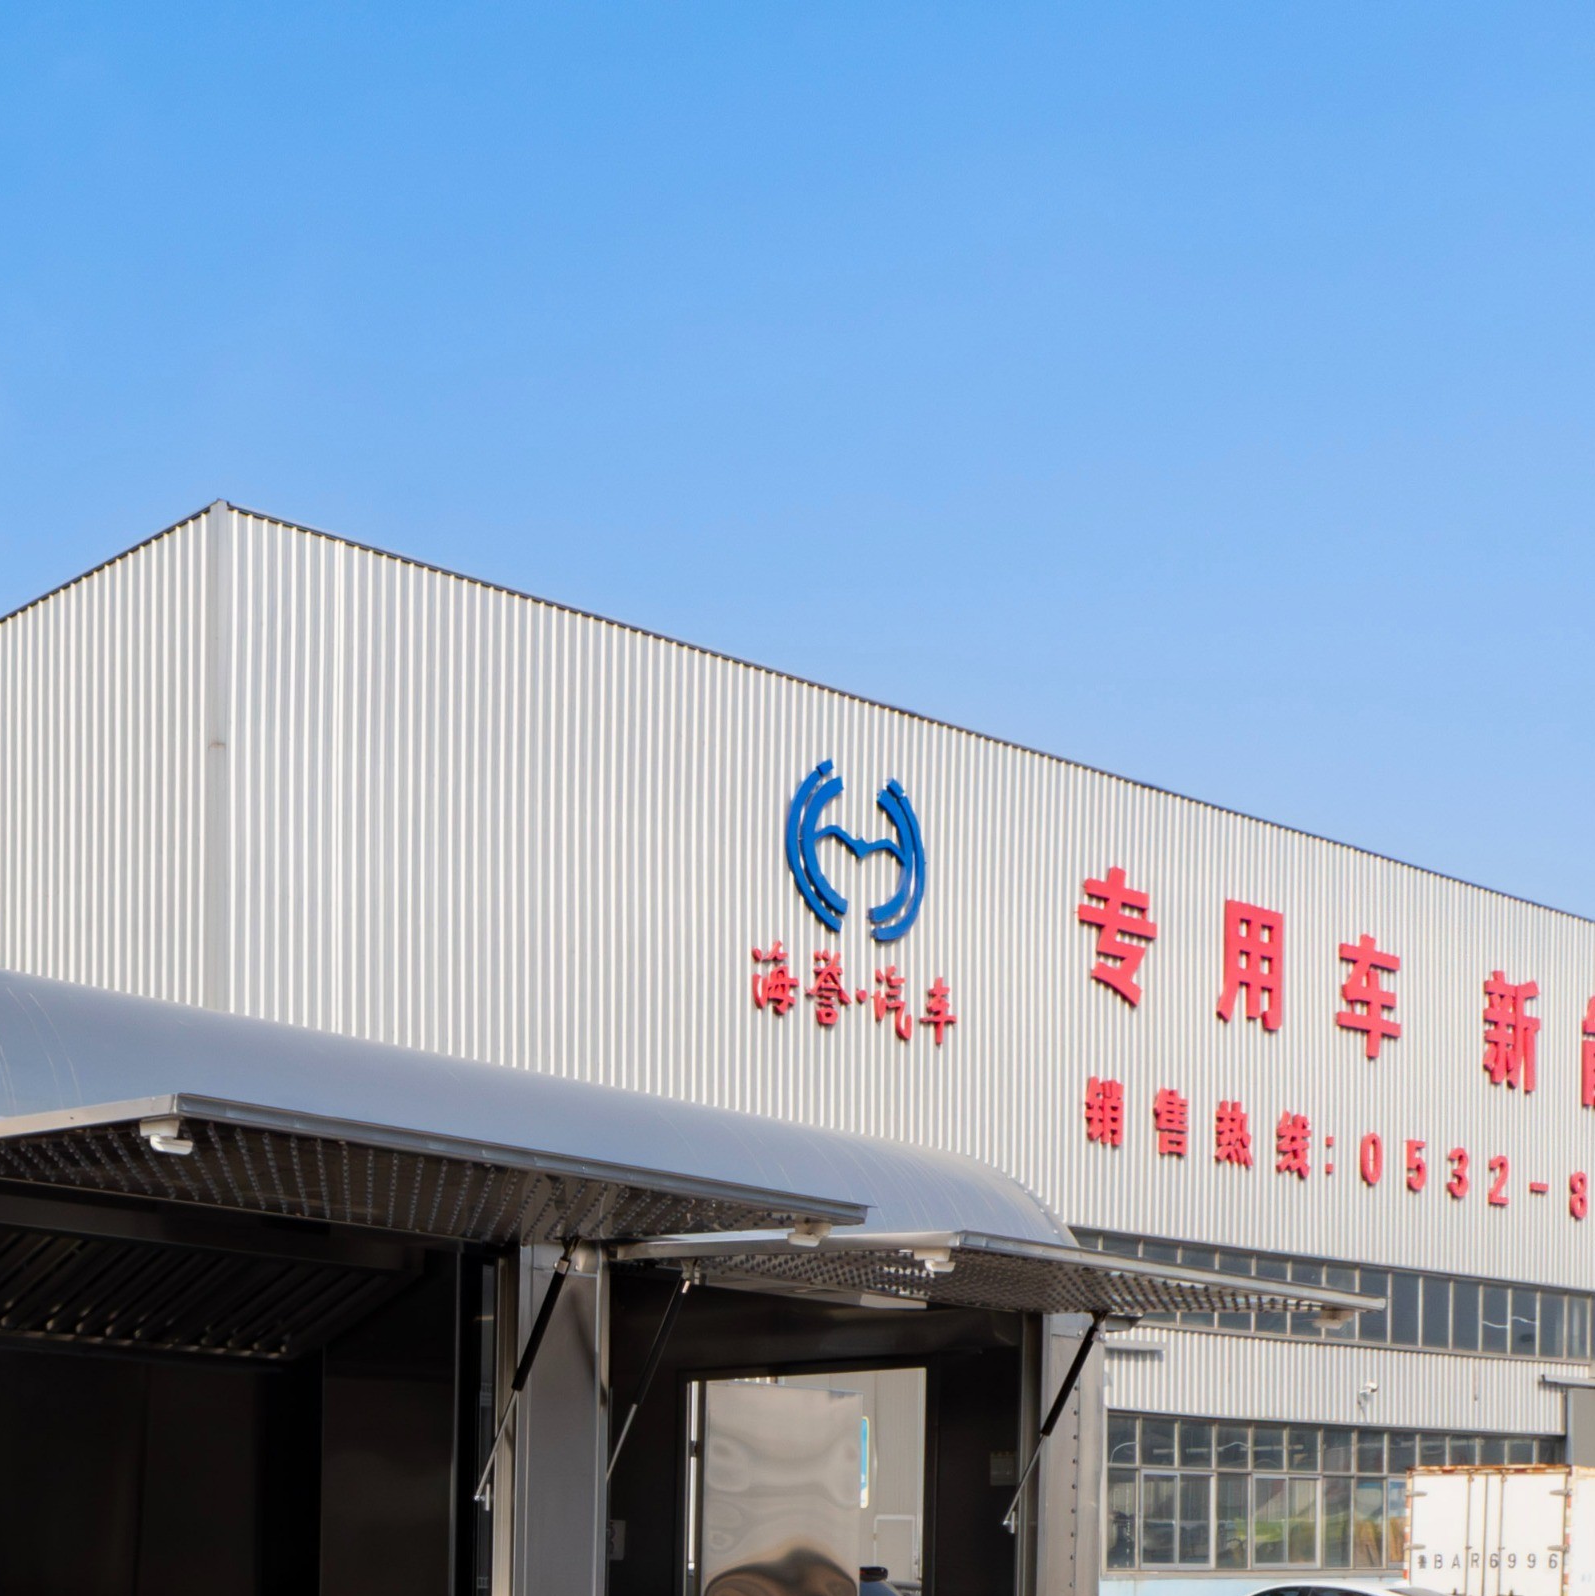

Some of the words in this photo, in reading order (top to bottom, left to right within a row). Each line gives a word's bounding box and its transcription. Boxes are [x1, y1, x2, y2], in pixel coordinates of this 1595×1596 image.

[1078, 866, 1401, 1059] 专用车
[1482, 970, 1595, 1108] 新
